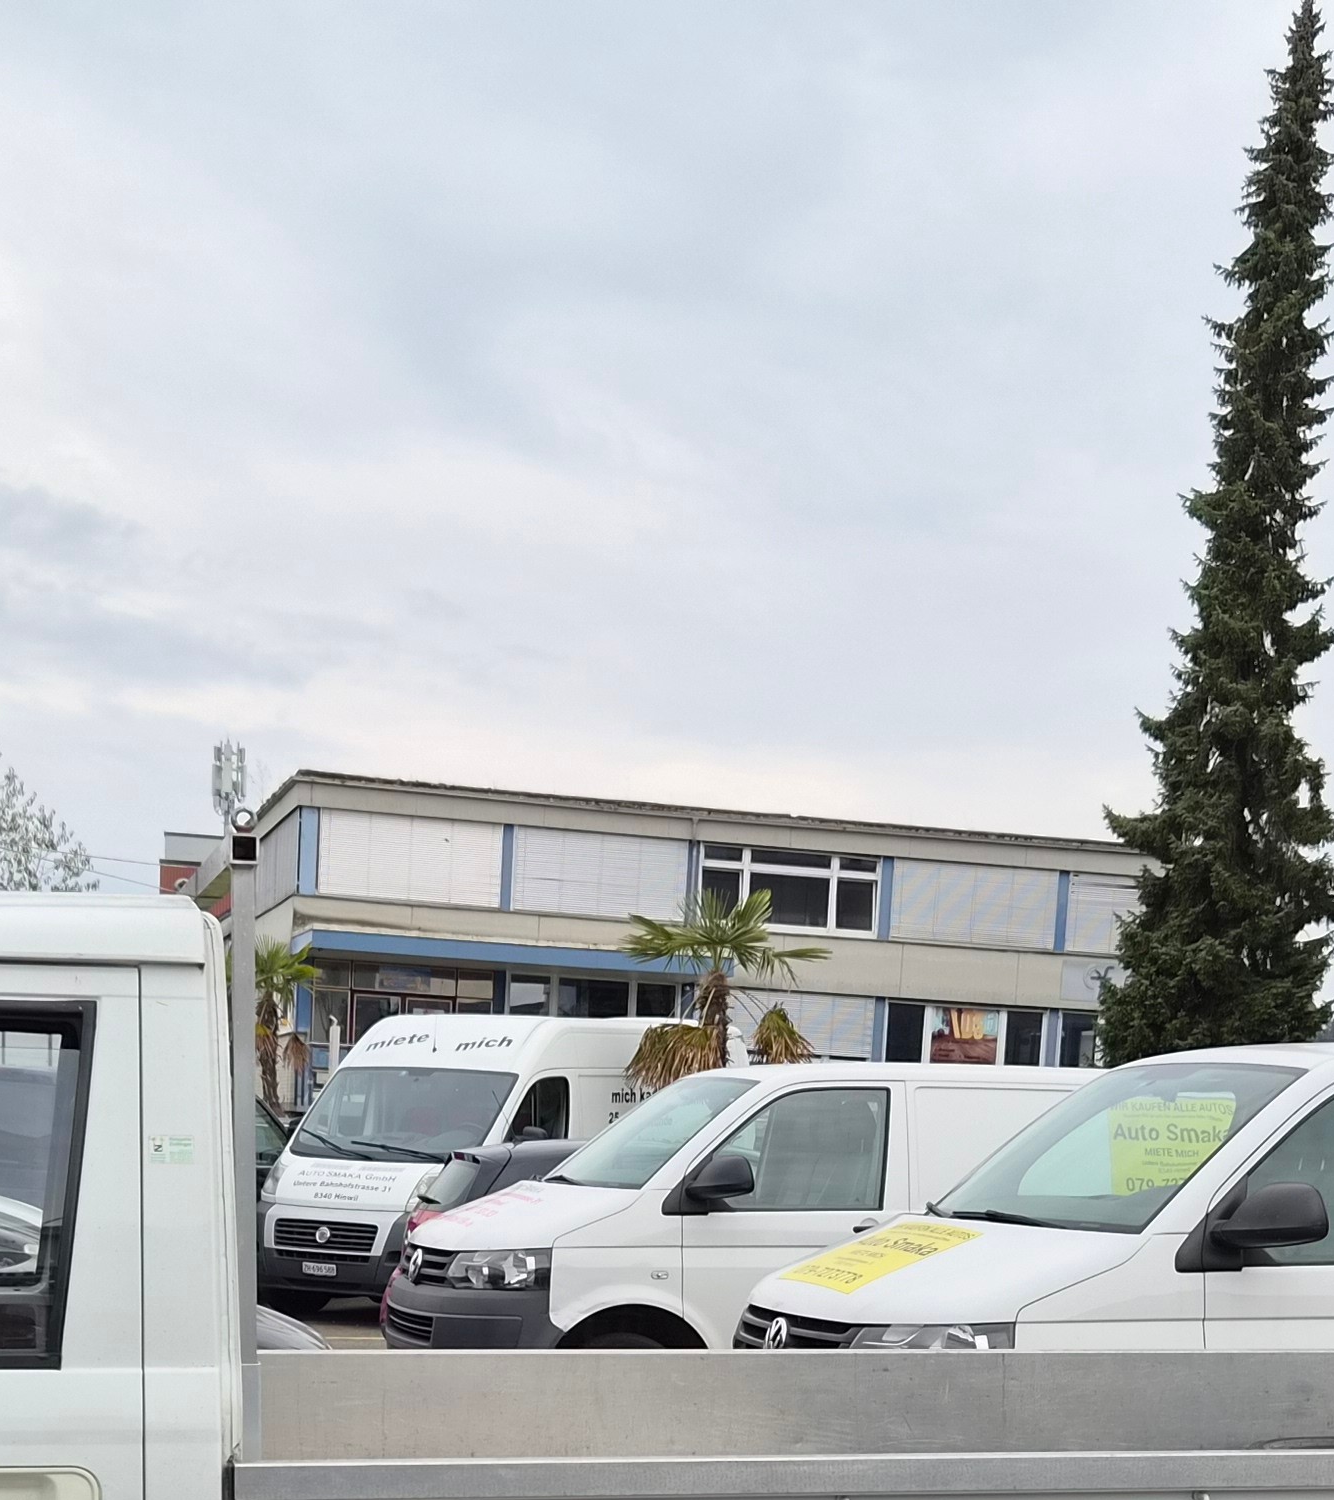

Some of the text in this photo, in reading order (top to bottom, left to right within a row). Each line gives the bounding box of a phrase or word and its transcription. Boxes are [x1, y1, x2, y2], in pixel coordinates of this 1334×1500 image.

[366, 1033, 514, 1052] miete mich
[611, 1088, 636, 1103] mich
[1131, 1102, 1170, 1112] KAUFEN
[1173, 1102, 1197, 1112] ALLE
[1113, 1123, 1160, 1141] Auto
[1144, 1147, 1199, 1158] MIETE MICH
